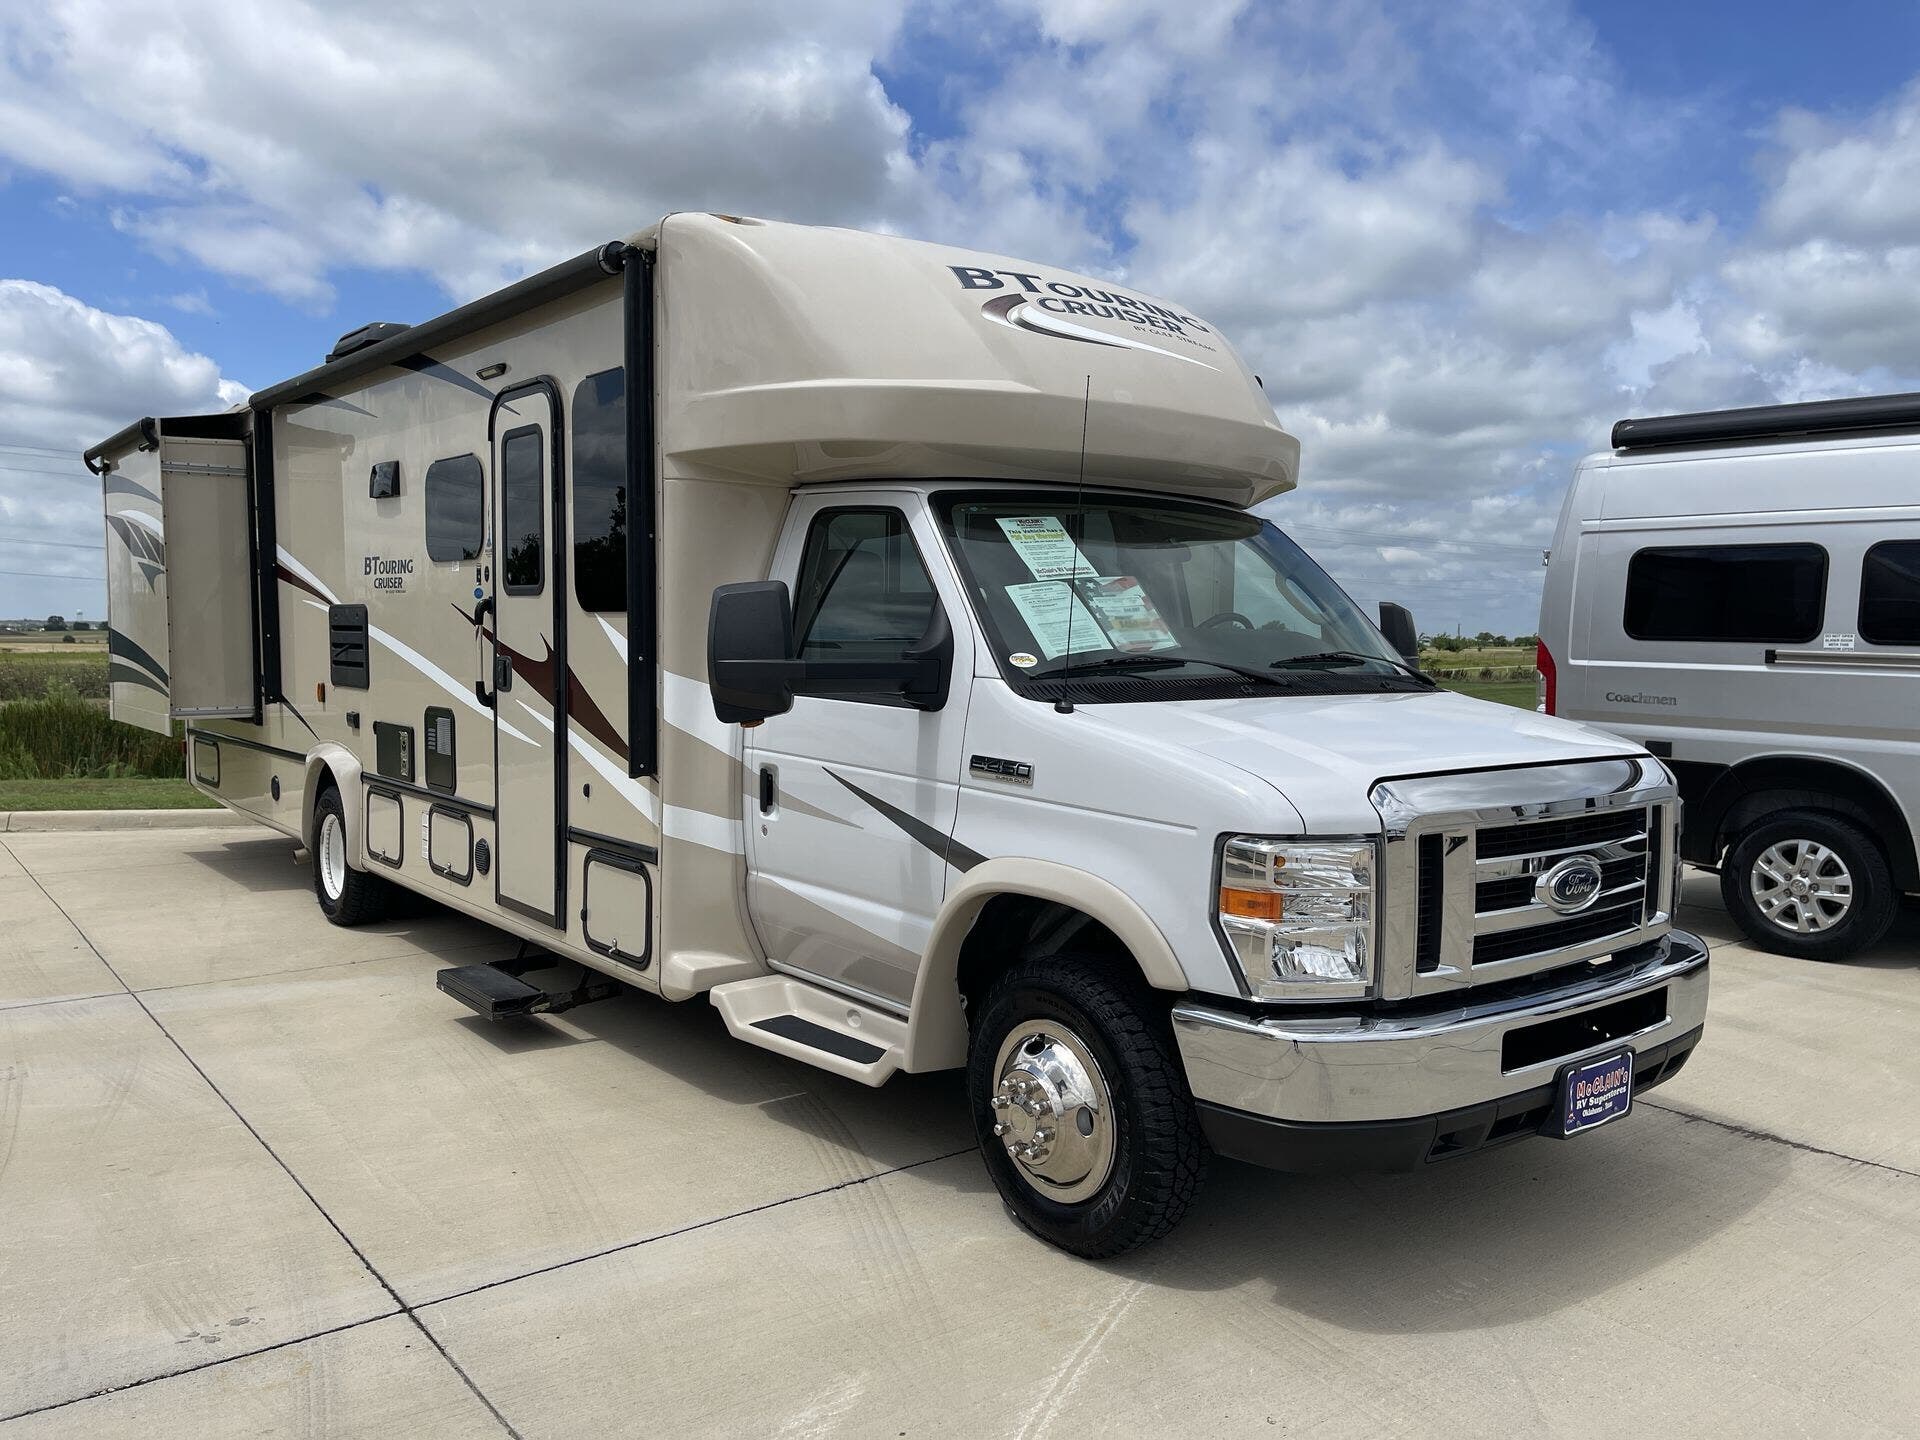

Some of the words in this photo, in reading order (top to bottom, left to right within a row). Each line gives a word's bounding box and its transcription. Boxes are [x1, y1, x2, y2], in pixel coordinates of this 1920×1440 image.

[1037, 297, 1188, 336] CRUISER
[373, 577, 403, 589] CRUISER
[1605, 691, 1678, 706] Coachmen
[1565, 873, 1594, 896] Ford
[1576, 1098, 1588, 1110] RV
[1588, 1086, 1626, 1106] Superstores
